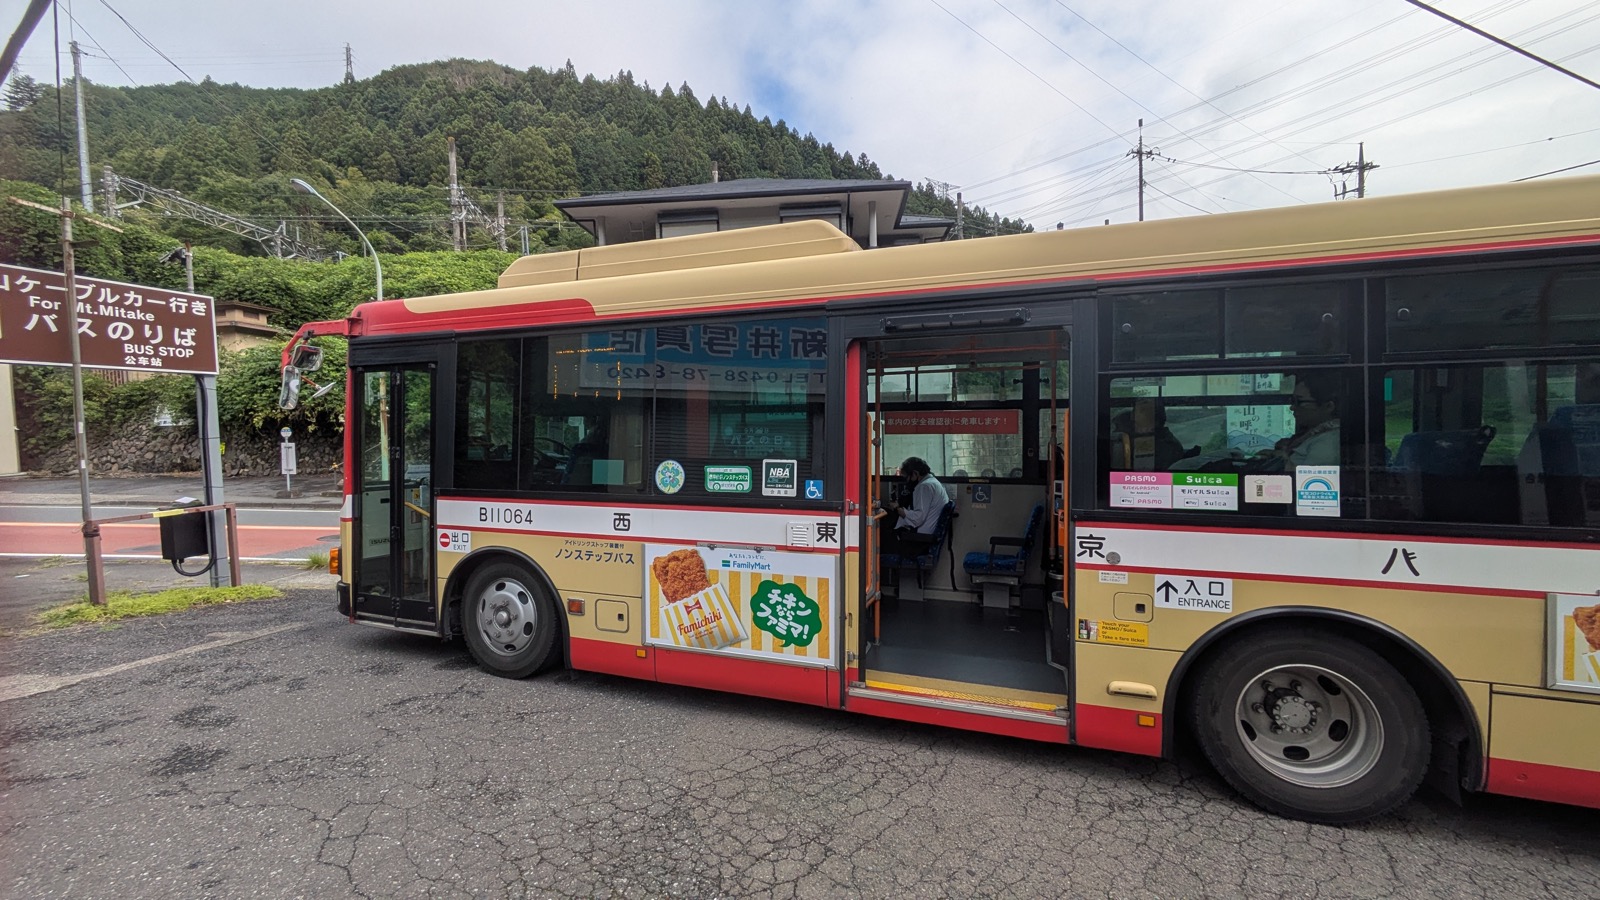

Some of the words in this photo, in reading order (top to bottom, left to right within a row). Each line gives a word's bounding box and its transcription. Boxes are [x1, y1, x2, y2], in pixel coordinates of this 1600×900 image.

[29, 296, 61, 311] For
[24, 313, 197, 347] バスのりば
[124, 344, 154, 356] BUS
[159, 347, 194, 358] STOP
[124, 355, 162, 367] 公车站
[769, 467, 790, 477] NBA
[1186, 475, 1222, 484] Suica
[479, 507, 533, 525] B11064
[451, 532, 470, 544] 出口
[613, 512, 631, 532] 西
[815, 521, 838, 543] 東
[1076, 533, 1106, 559] 京
[555, 548, 635, 565] ノンステップバス
[732, 560, 771, 571] FamilyMart
[1184, 579, 1224, 597] 入口
[767, 588, 812, 617] チキン
[1177, 597, 1231, 610] ENTRANCE
[776, 605, 795, 621] なら
[677, 608, 723, 637] Famichiki
